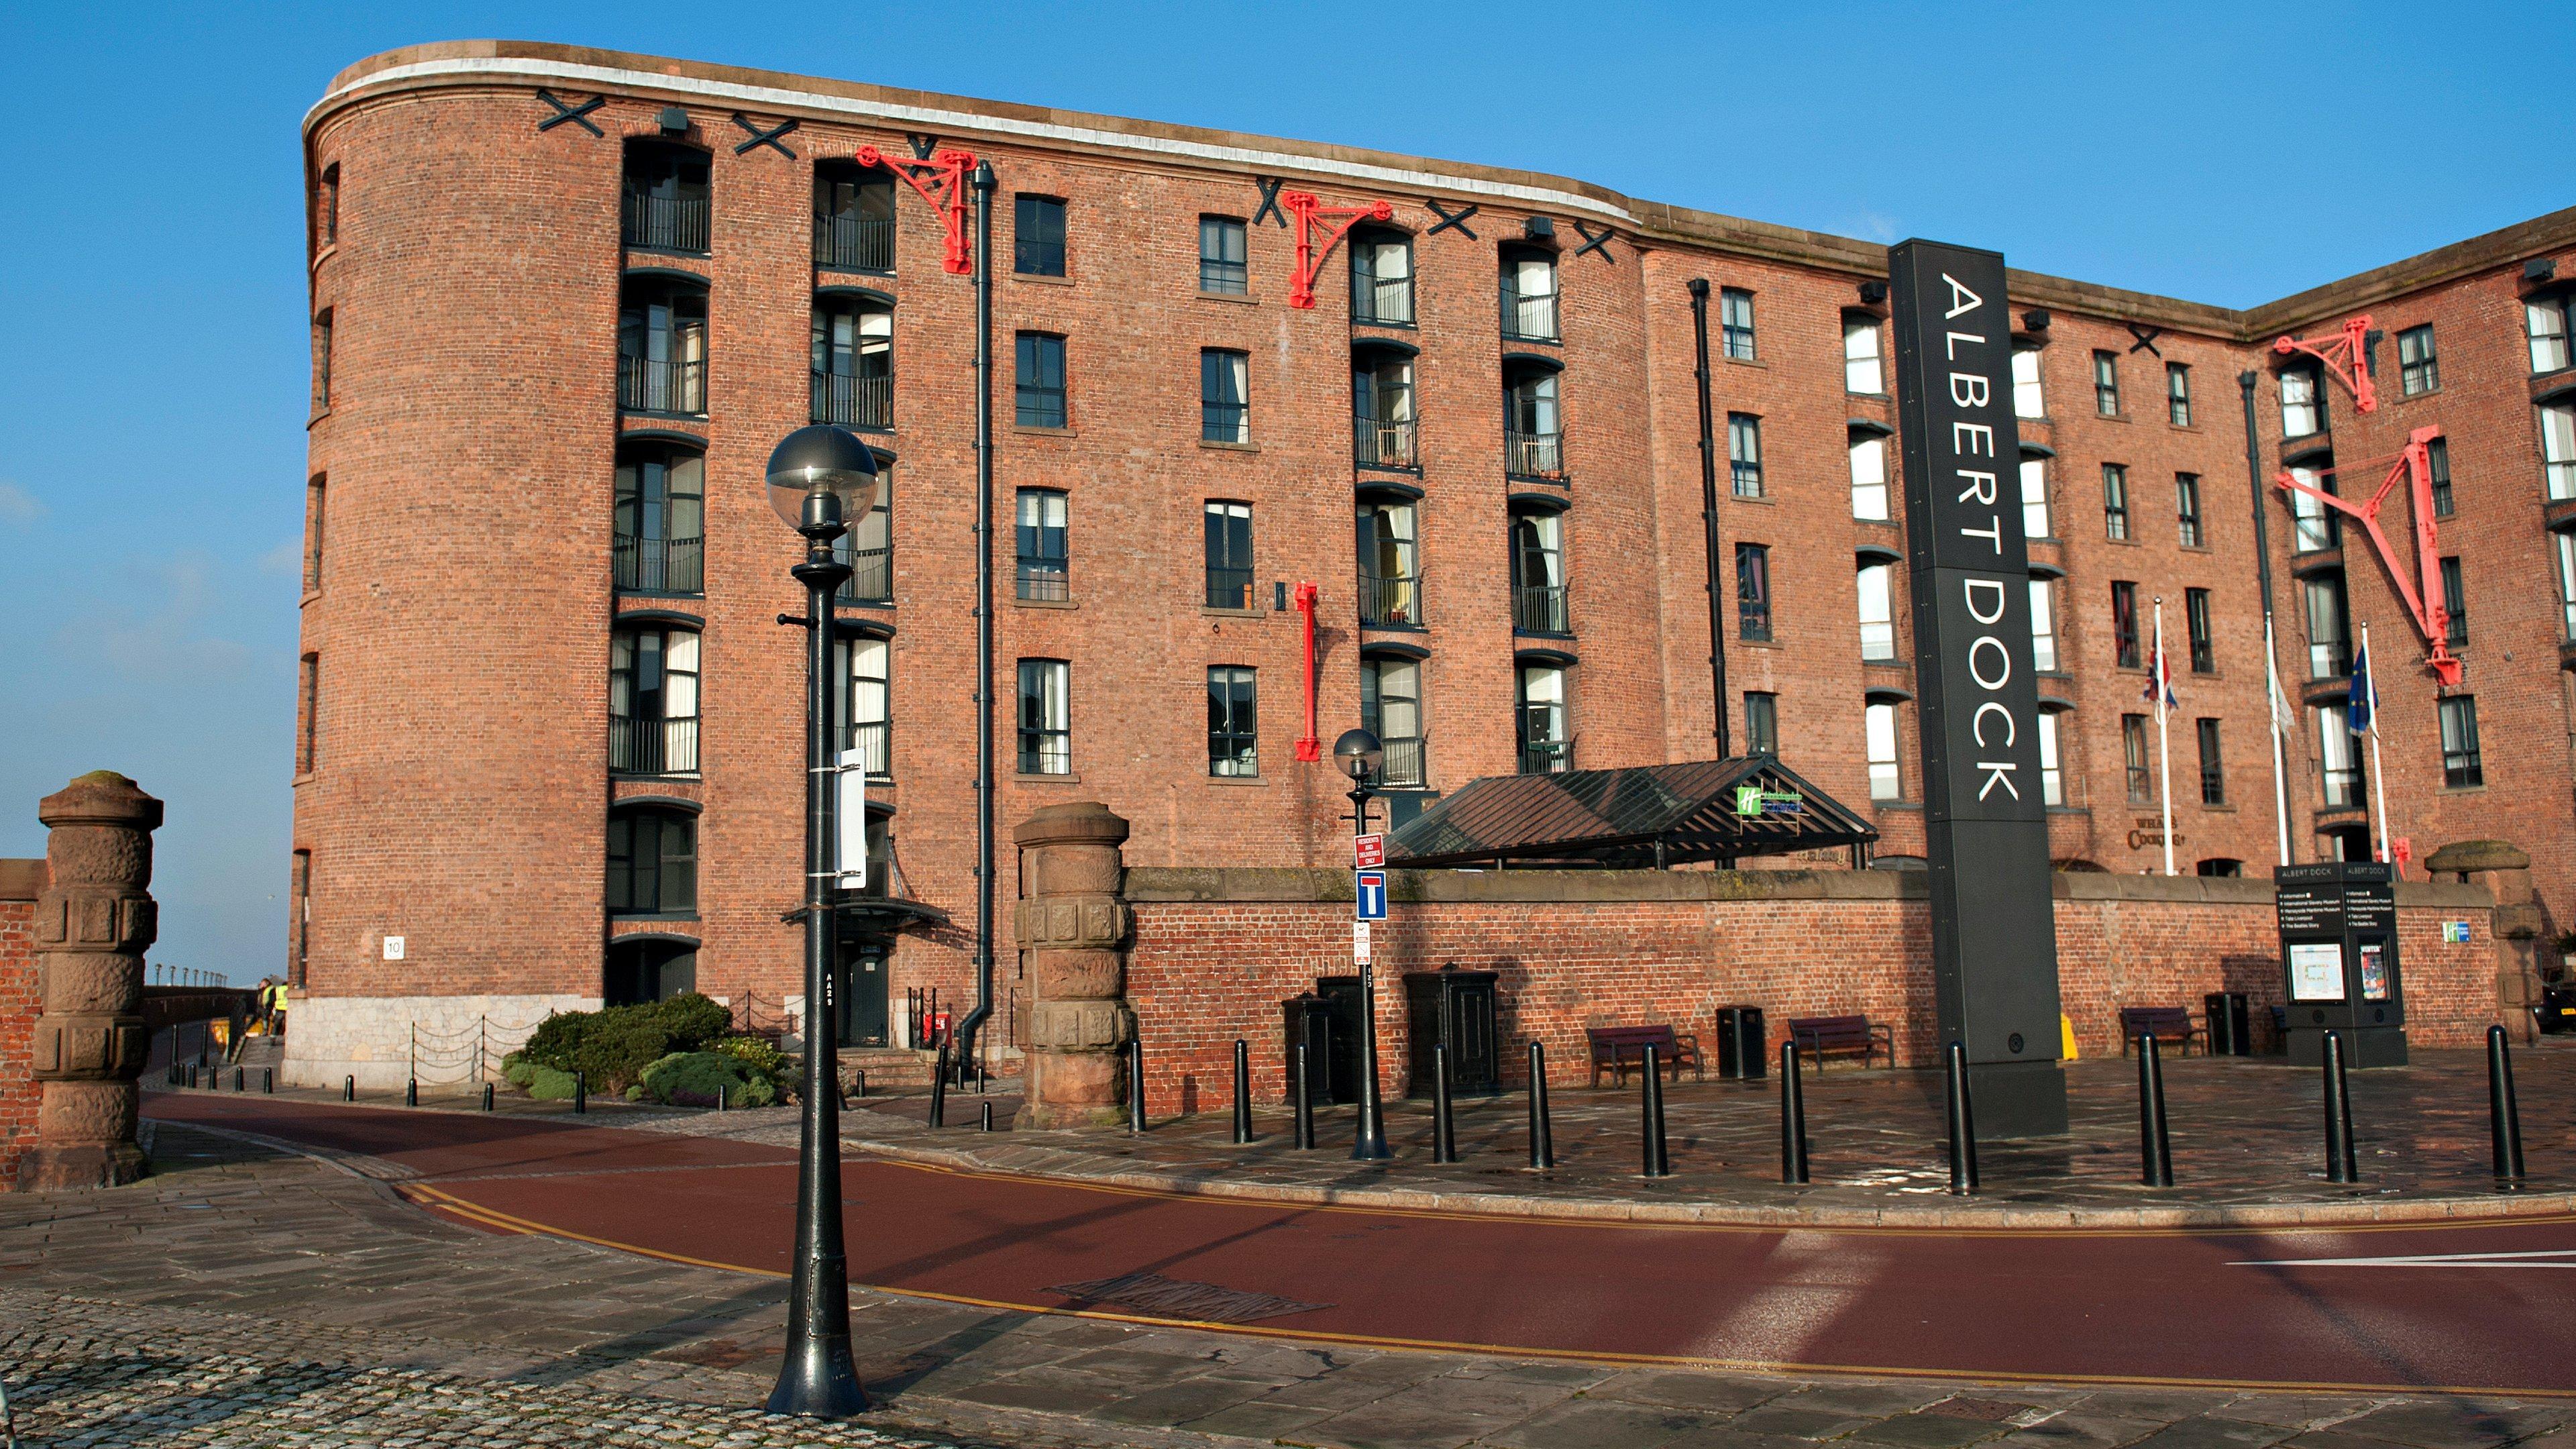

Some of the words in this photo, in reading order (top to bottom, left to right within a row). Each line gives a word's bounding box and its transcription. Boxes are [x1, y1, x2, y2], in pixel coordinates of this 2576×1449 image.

[1942, 272, 2001, 555] ALBERT
[1964, 578, 2019, 801] DOCK
[1358, 837, 1379, 845] RESIDENTS
[1358, 850, 1381, 859] DELIVERIES
[2282, 869, 2308, 877] ALBERT
[2310, 867, 2332, 876] DOCK
[2348, 867, 2367, 875] ALBERT
[2369, 867, 2385, 875] DOCK
[388, 942, 400, 953] 10
